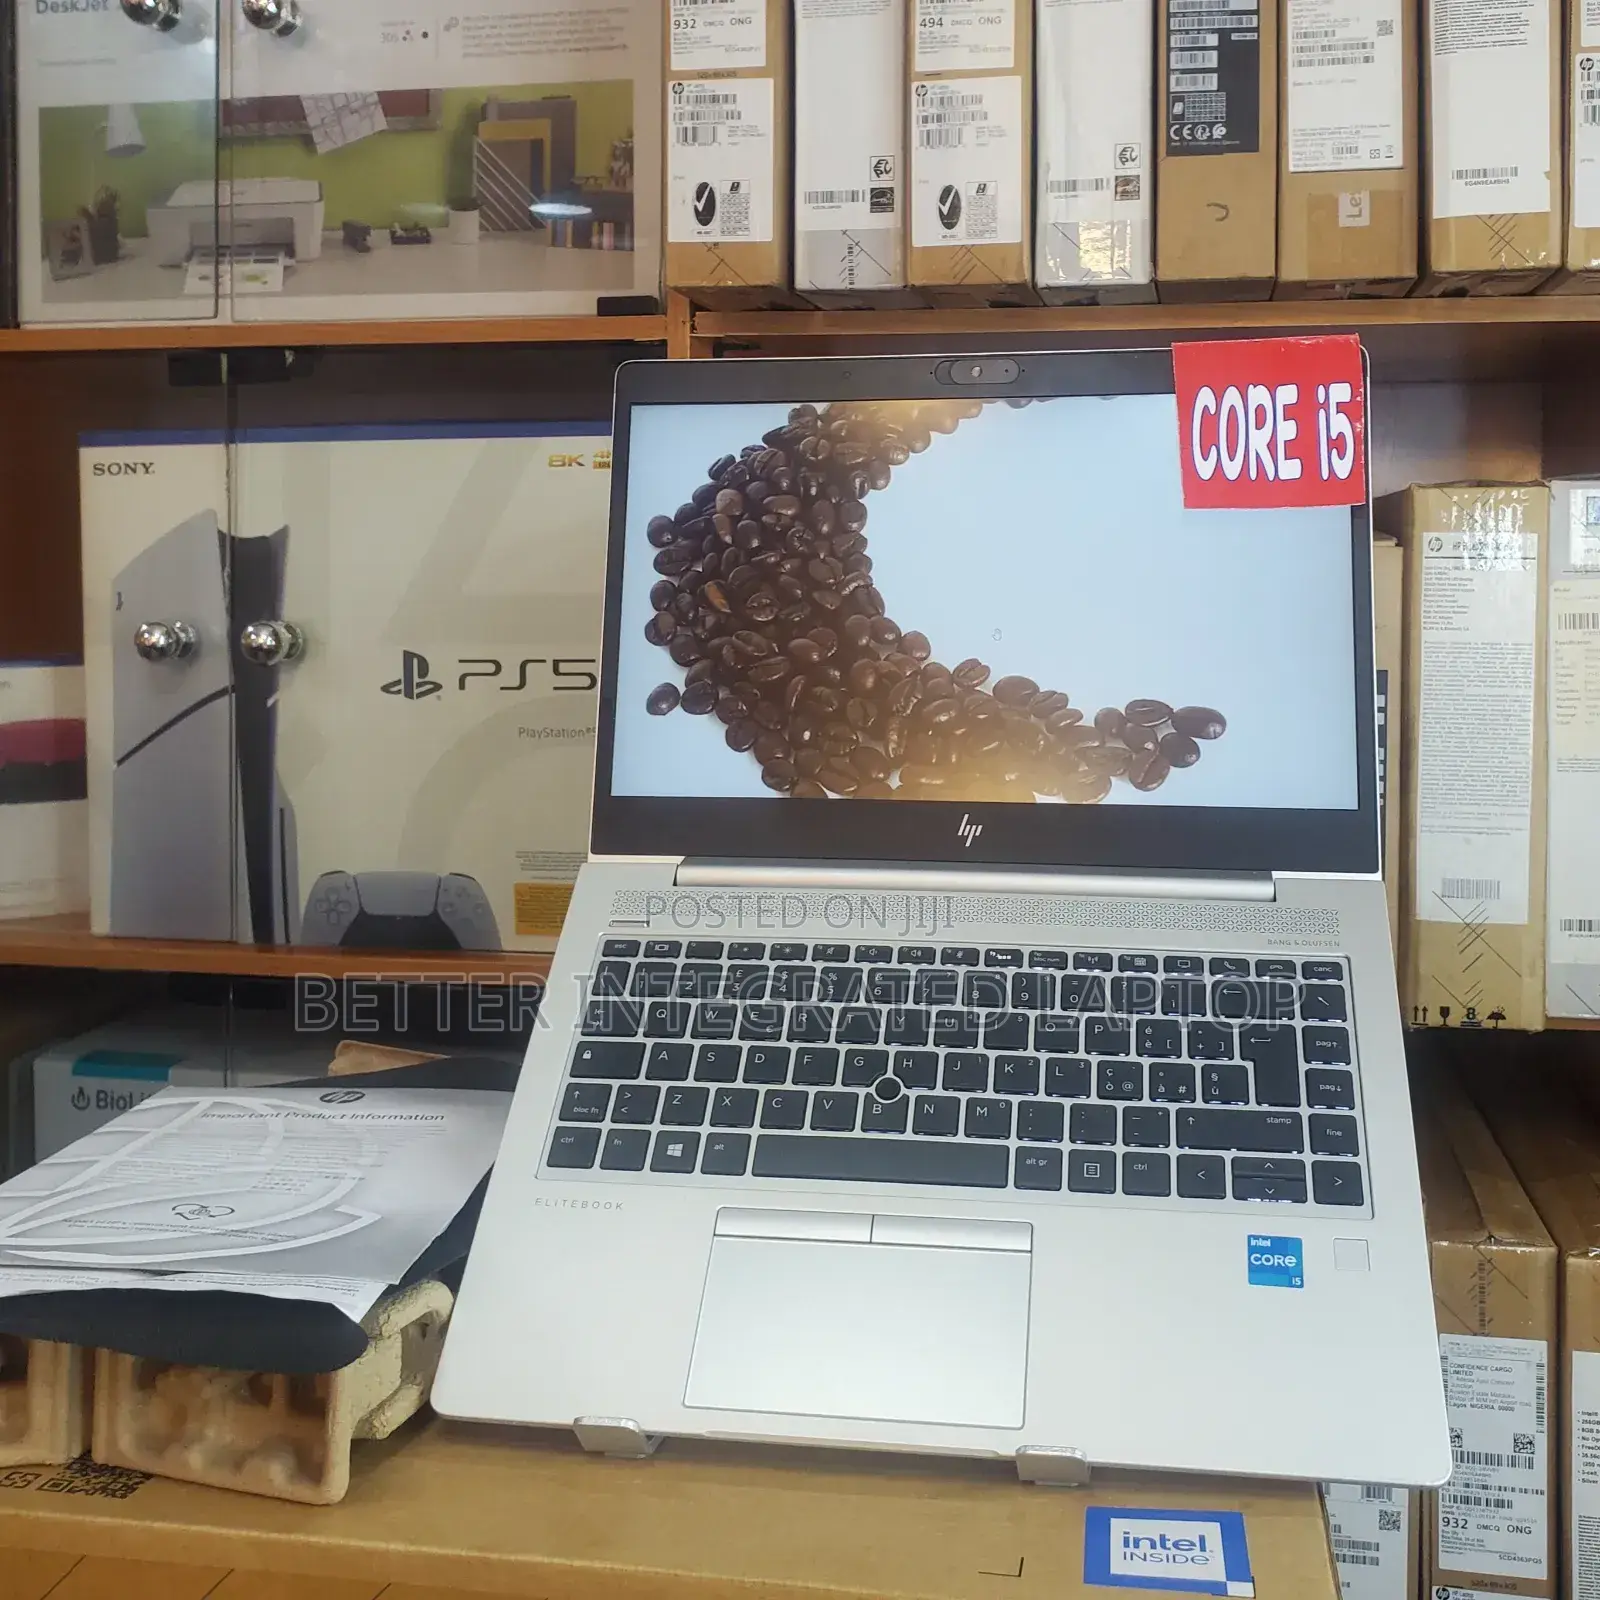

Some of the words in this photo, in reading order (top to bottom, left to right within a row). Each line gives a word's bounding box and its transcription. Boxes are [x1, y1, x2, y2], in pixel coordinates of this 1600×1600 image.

[673, 18, 697, 30] 932
[729, 16, 752, 26] ONG
[919, 17, 944, 28] 494
[978, 16, 1001, 25] ONG
[1192, 383, 1303, 482] CORE
[1317, 381, 1355, 481] i5
[548, 453, 586, 467] 8K
[458, 659, 598, 691] PS5
[957, 813, 983, 847] hp
[1313, 965, 1333, 973] canc
[685, 981, 693, 990] 2
[733, 982, 740, 991] 3
[778, 984, 787, 993] 4
[827, 985, 834, 994] 5
[874, 986, 882, 996] 6
[1020, 992, 1029, 1001] 9
[656, 1009, 667, 1020] Q
[703, 1010, 719, 1020] W
[750, 1011, 760, 1021] E
[798, 1013, 808, 1023] R
[1467, 1007, 1476, 1020] 8
[846, 1014, 856, 1025] T
[895, 1015, 906, 1027] Y
[944, 1018, 955, 1028] U
[1094, 1025, 1104, 1035] P
[658, 1051, 669, 1061] A
[706, 1051, 716, 1063] S
[755, 1053, 765, 1063] D
[803, 1055, 812, 1066] F
[854, 1056, 865, 1067] G
[903, 1058, 913, 1068] H
[953, 1060, 961, 1071] J
[1005, 1063, 1015, 1074] K
[1056, 1066, 1064, 1076] L
[1122, 1080, 1134, 1092] @
[1178, 1085, 1187, 1094] #
[672, 1094, 683, 1104] Z
[721, 1096, 732, 1106] X
[772, 1098, 782, 1108] C
[822, 1099, 834, 1110] V
[872, 1104, 882, 1114] B
[924, 1104, 934, 1115] N
[201, 1111, 282, 1120] Important
[284, 1111, 347, 1120] Product
[350, 1112, 445, 1121] Information
[976, 1106, 988, 1117] M
[1266, 1116, 1292, 1125] stamp
[1326, 1128, 1342, 1137] fine
[560, 1136, 574, 1144] ctrl
[713, 1143, 725, 1151] alt
[1025, 1157, 1037, 1166] alt
[1038, 1158, 1048, 1168] gr
[1133, 1162, 1148, 1171] ctrl
[534, 1198, 624, 1210] ELITEBOOK
[1250, 1237, 1271, 1247] intel
[1292, 1276, 1302, 1285] i5
[1449, 1362, 1489, 1372] CONFIDENCE
[1489, 1365, 1513, 1373] CARGO
[1449, 1369, 1474, 1377] LIMITED
[1441, 1516, 1469, 1530] 932
[1476, 1523, 1501, 1532] DMCQ
[1506, 1524, 1532, 1535] ONG
